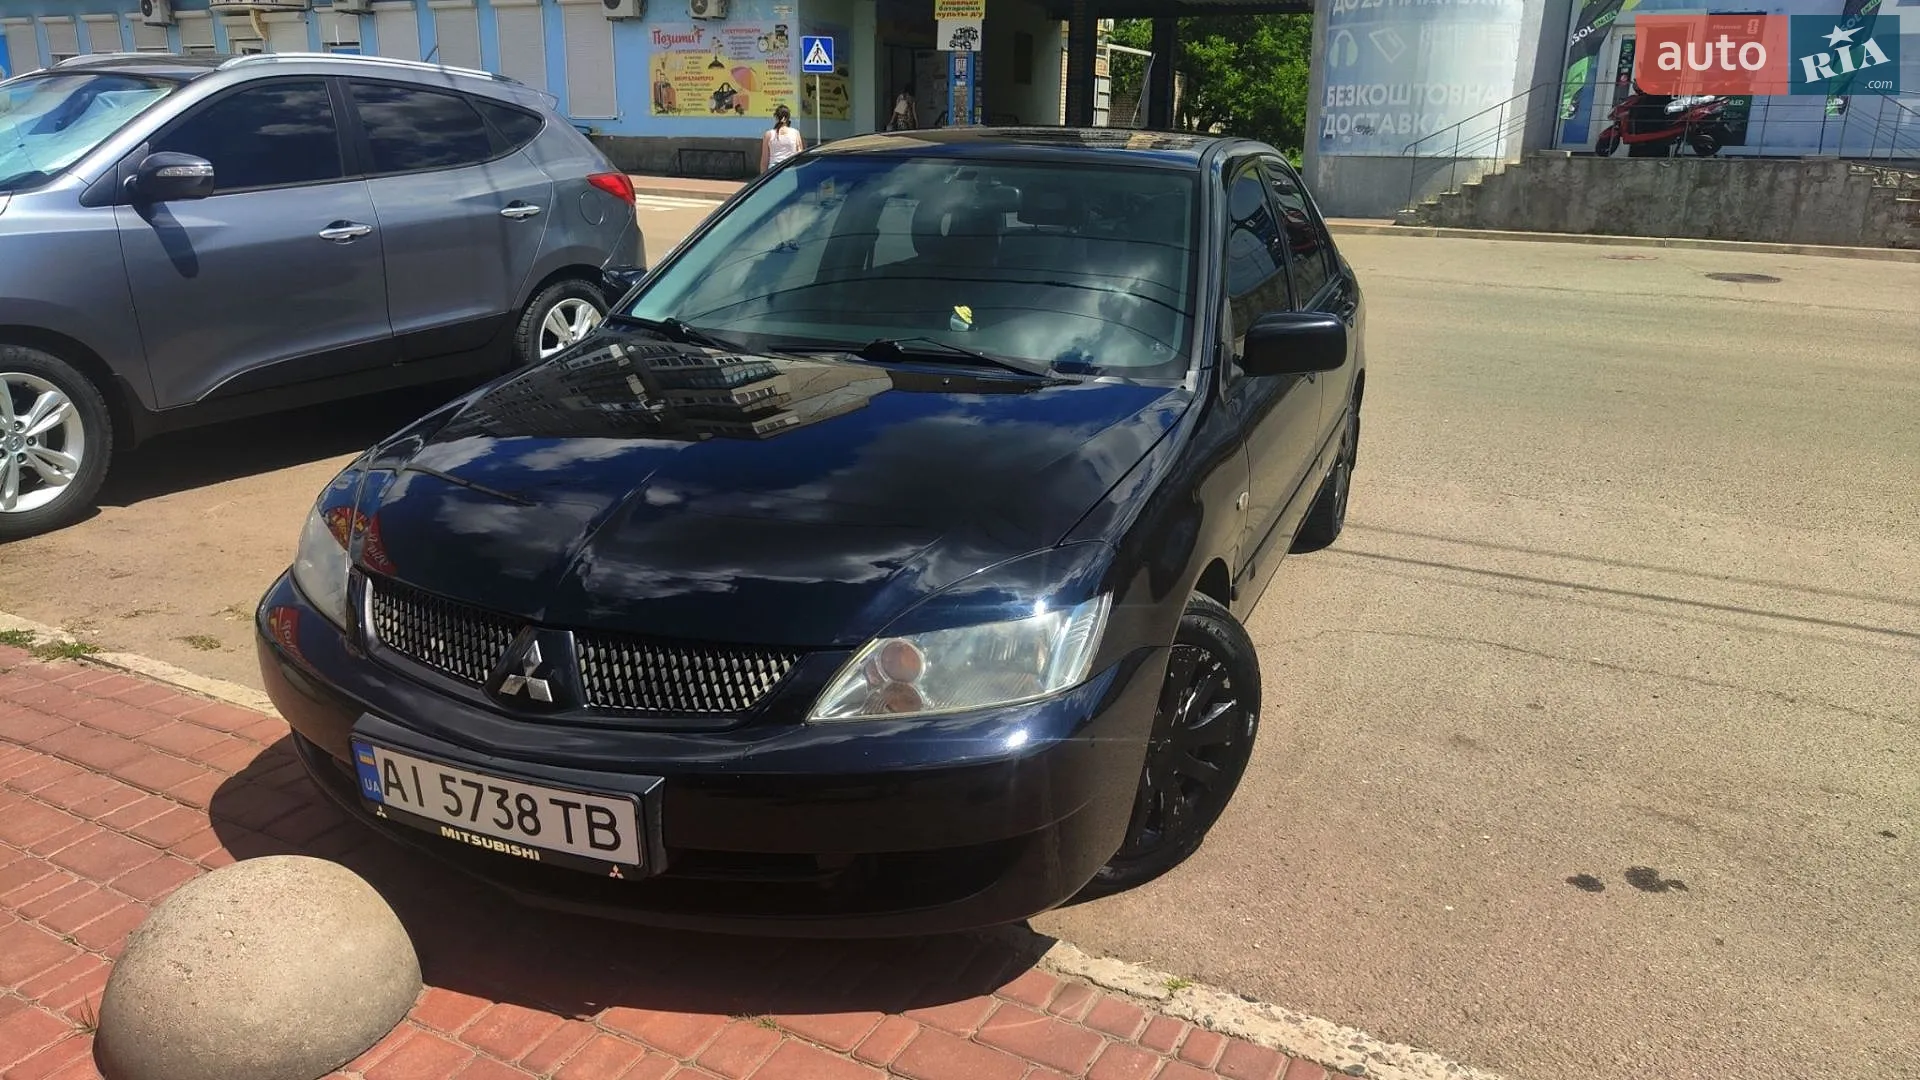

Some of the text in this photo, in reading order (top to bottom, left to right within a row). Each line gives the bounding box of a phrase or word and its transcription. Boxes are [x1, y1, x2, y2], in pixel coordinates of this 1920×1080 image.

[1327, 82, 1497, 107] БЕЗКОШТОВНА
[1323, 112, 1450, 139] ДОСТАВКА
[364, 777, 381, 793] UA
[383, 757, 621, 852] AI 5738 TB
[440, 825, 540, 861] MITSUBISHI
